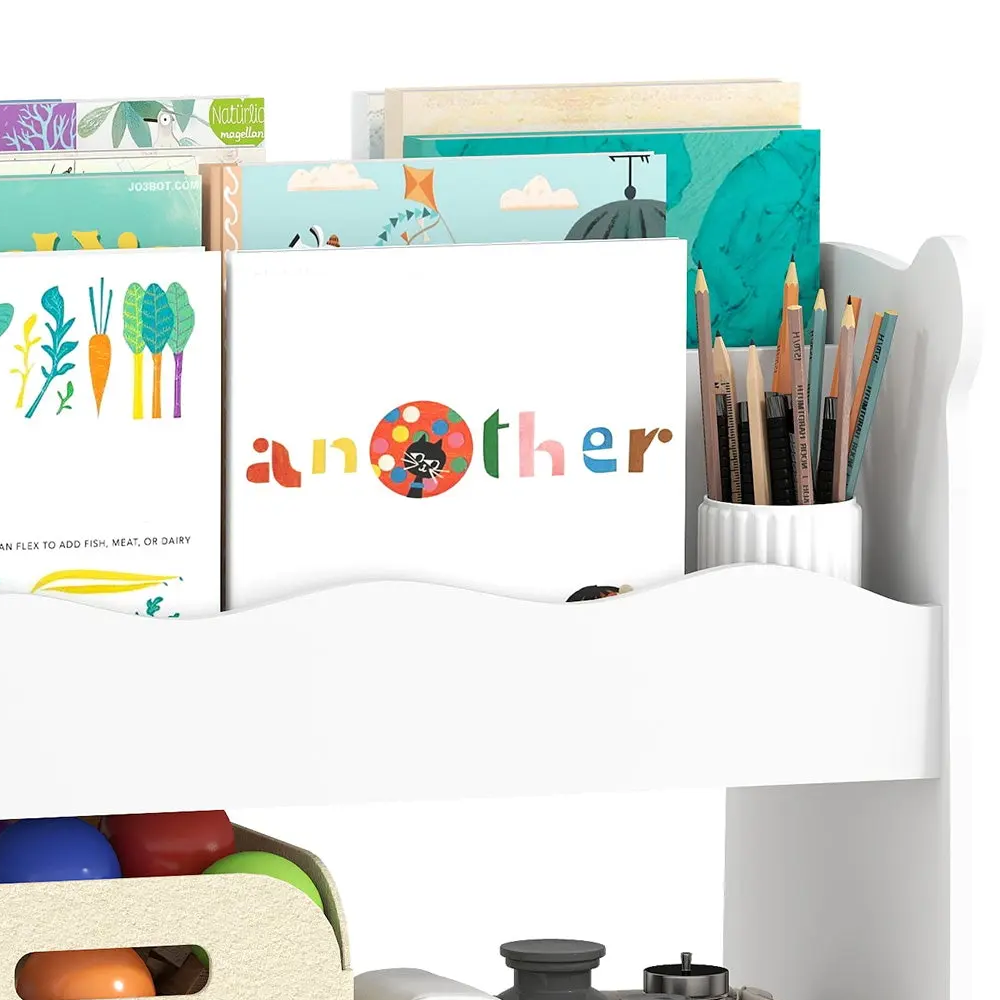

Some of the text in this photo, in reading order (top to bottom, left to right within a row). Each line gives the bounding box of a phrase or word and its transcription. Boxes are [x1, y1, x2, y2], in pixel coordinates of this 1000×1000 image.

[246, 399, 673, 499] another
[16, 541, 40, 550] FLEX
[43, 541, 56, 549] TO
[59, 540, 81, 549] ADD
[84, 539, 109, 549] FISH,
[112, 537, 141, 547] MEAT,
[144, 537, 158, 546] OR
[161, 536, 191, 545] DAIRY
